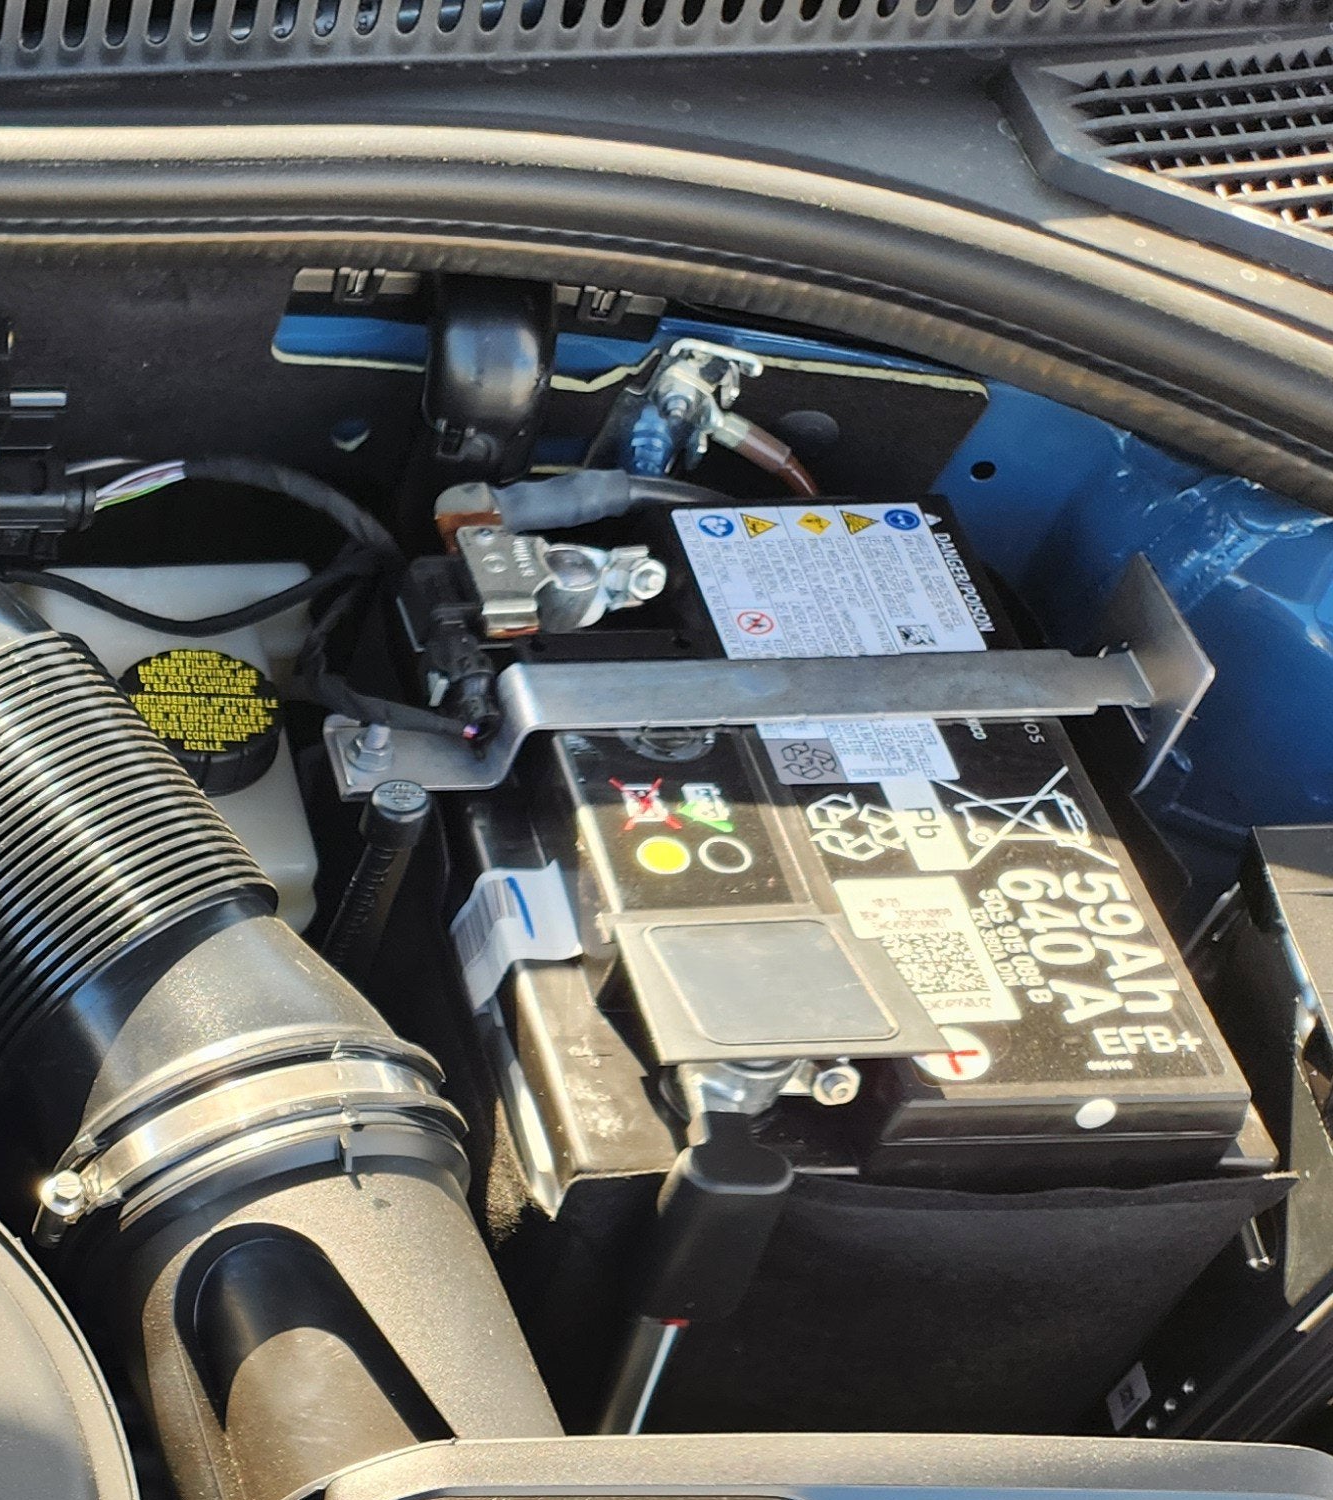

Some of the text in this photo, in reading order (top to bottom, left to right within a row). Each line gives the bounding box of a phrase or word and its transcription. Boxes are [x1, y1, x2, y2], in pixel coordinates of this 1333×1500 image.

[935, 532, 995, 632] DANGER/POISON
[904, 807, 941, 839] Pb
[996, 924, 1029, 955] 915
[1026, 988, 1053, 1004] B
[997, 868, 1097, 966] 640
[1048, 979, 1123, 1024] A
[1062, 871, 1180, 1014] 59Ah
[1092, 1024, 1203, 1056] EFB+
